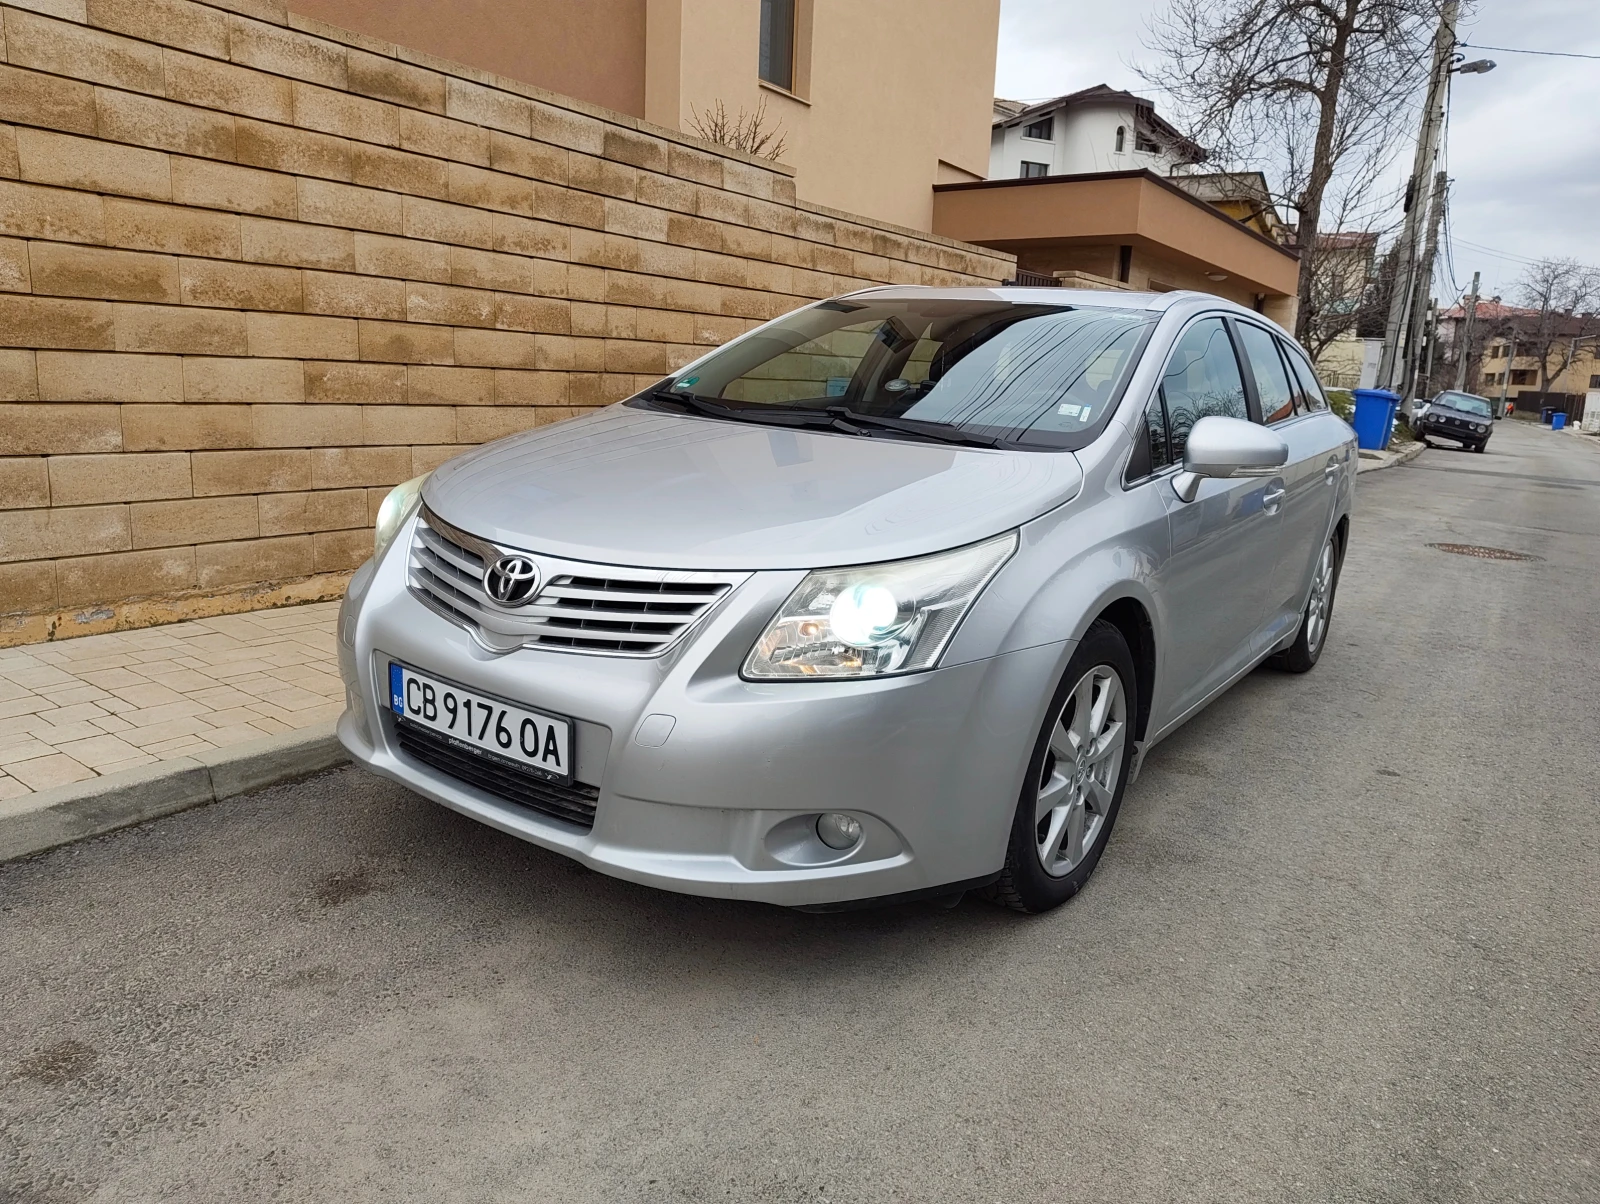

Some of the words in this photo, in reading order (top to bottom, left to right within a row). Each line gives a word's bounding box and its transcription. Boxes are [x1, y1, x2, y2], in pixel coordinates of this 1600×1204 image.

[393, 694, 403, 708] BG
[406, 677, 438, 722] CB
[443, 691, 513, 749] 9176
